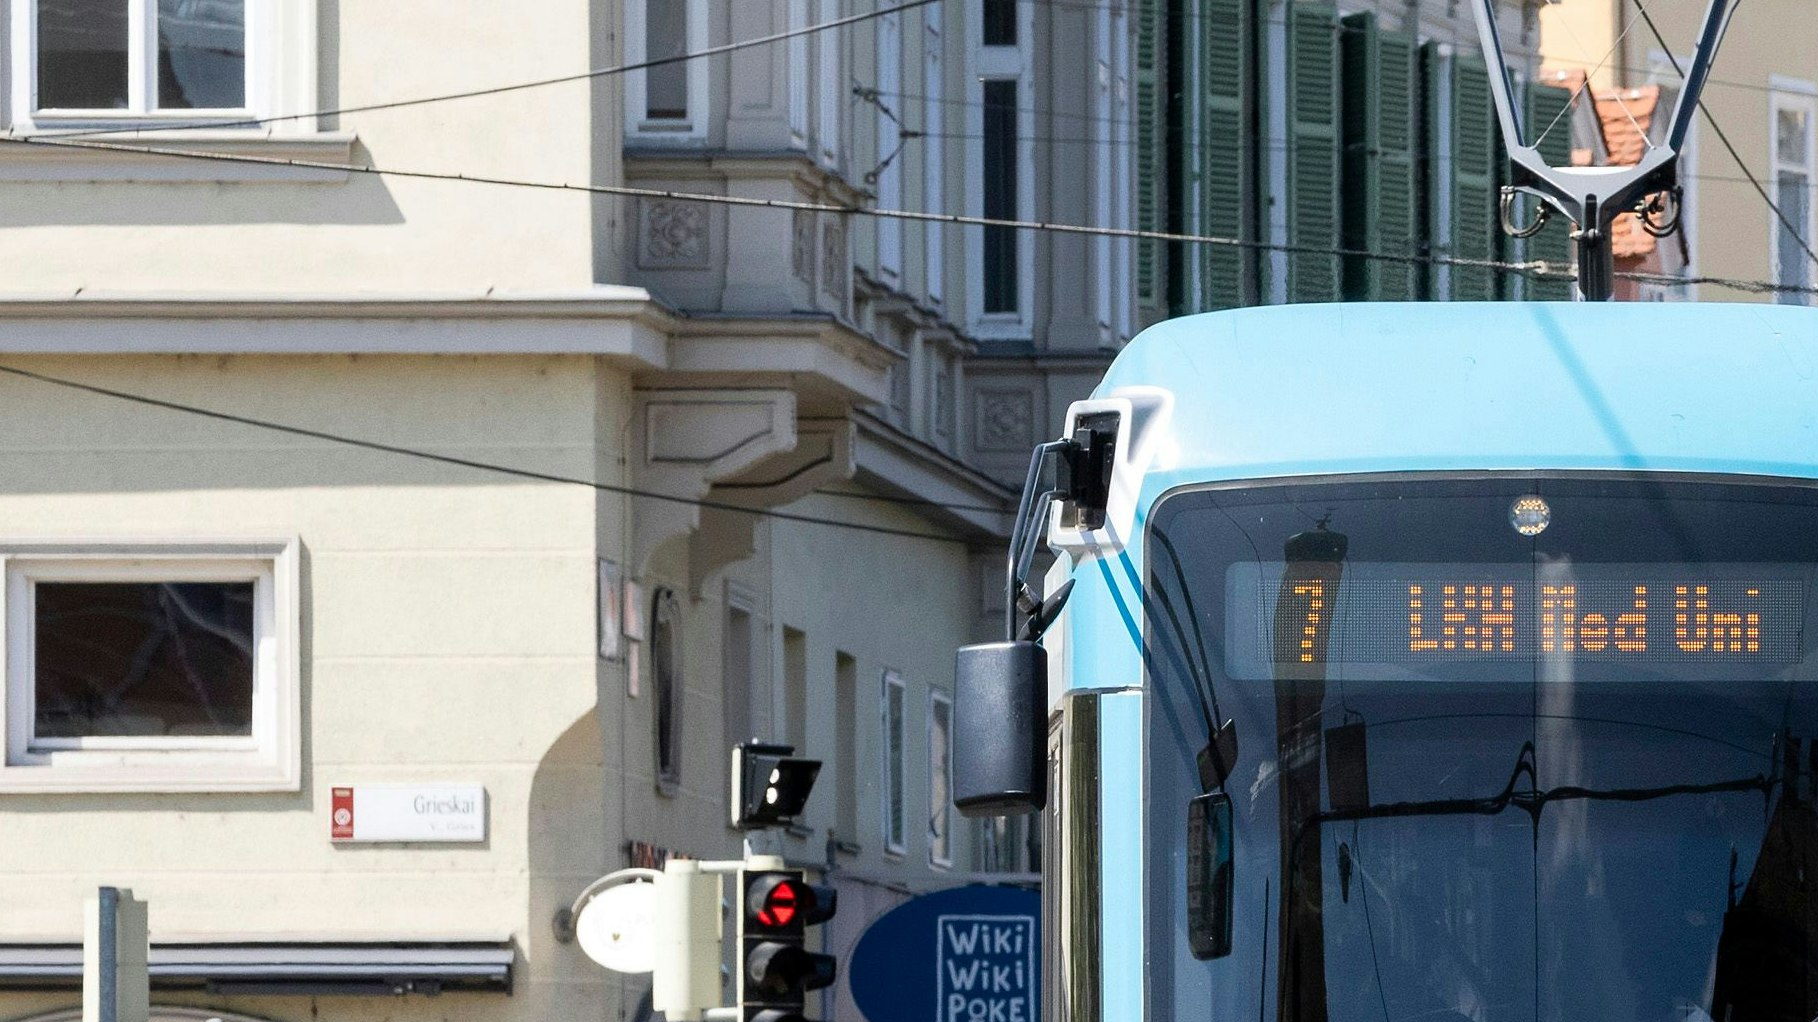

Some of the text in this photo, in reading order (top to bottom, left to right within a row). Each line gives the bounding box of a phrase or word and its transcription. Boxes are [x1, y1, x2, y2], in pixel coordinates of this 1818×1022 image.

[1295, 580, 1758, 662] 7 LKH Med Uni
[413, 792, 475, 814] Grieskai
